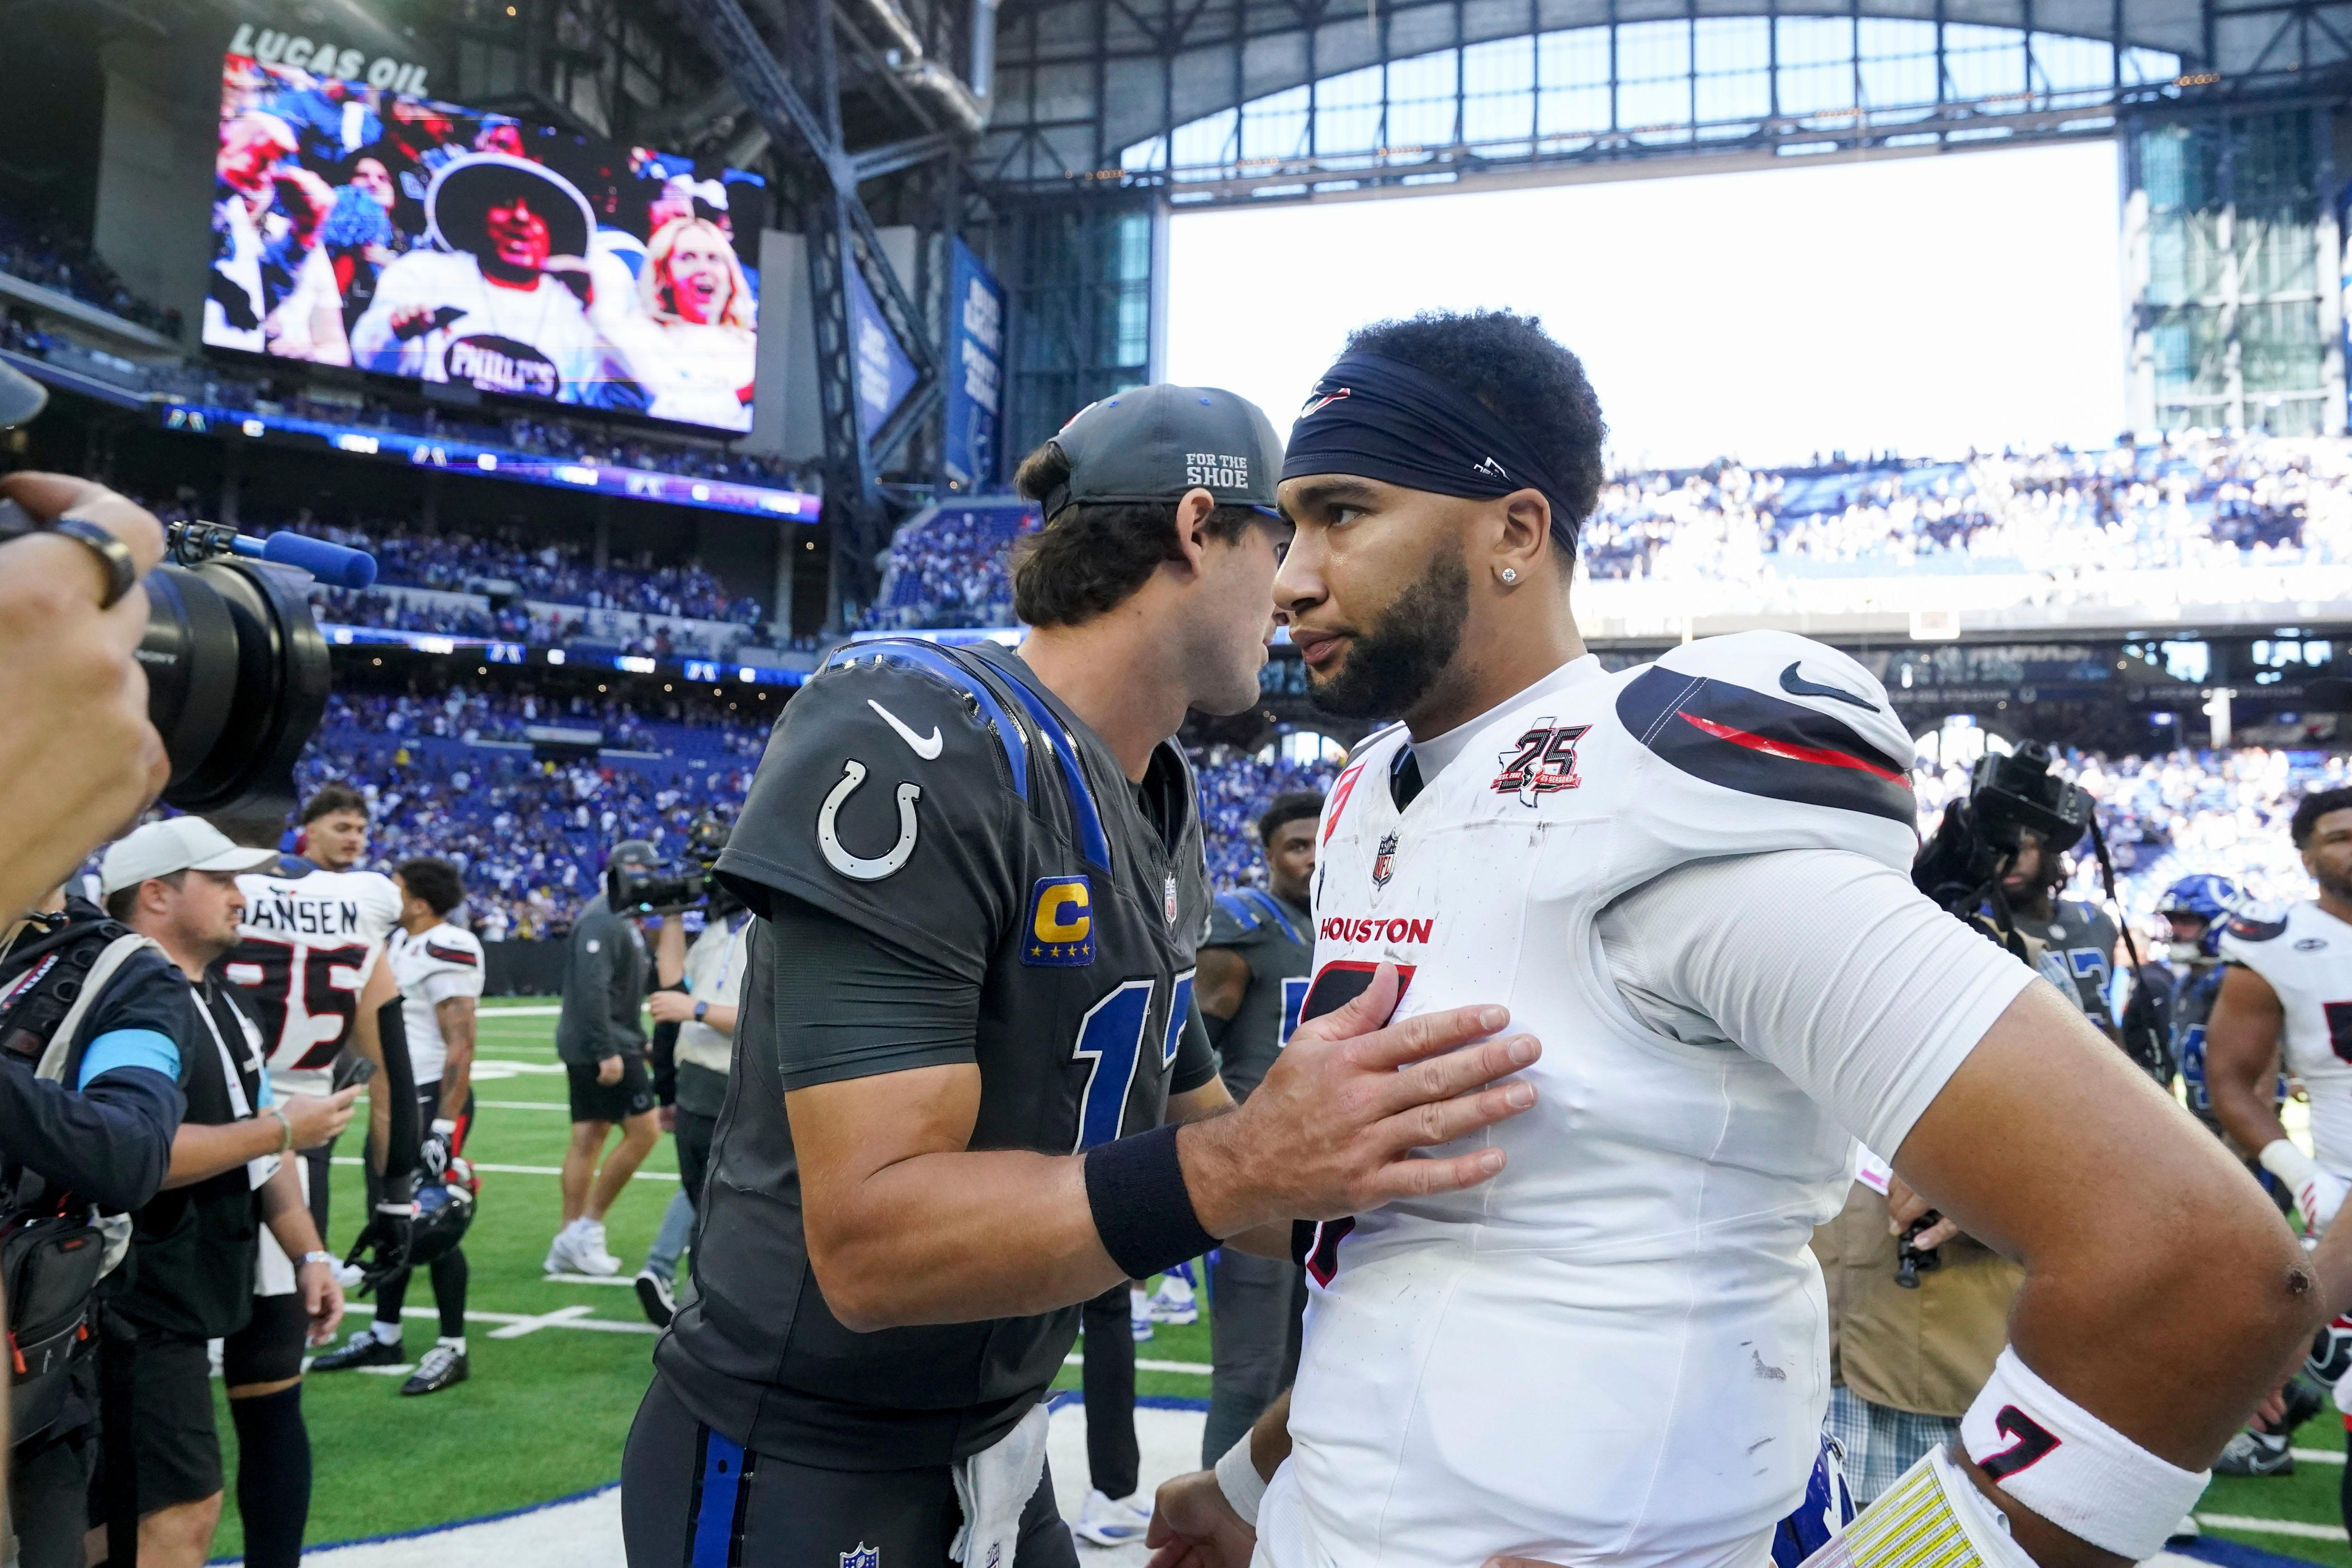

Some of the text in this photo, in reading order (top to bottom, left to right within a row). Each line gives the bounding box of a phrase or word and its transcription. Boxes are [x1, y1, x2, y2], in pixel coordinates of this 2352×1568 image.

[228, 23, 428, 98] LUCAS OIL
[1186, 453, 1248, 469] FOR THE
[1187, 466, 1248, 489] SHOE
[1494, 724, 1594, 794] 25
[1374, 856, 1392, 879] NFL
[1034, 882, 1090, 943] C
[1320, 917, 1434, 944] HOUSTON
[1976, 1404, 2062, 1485] 7
